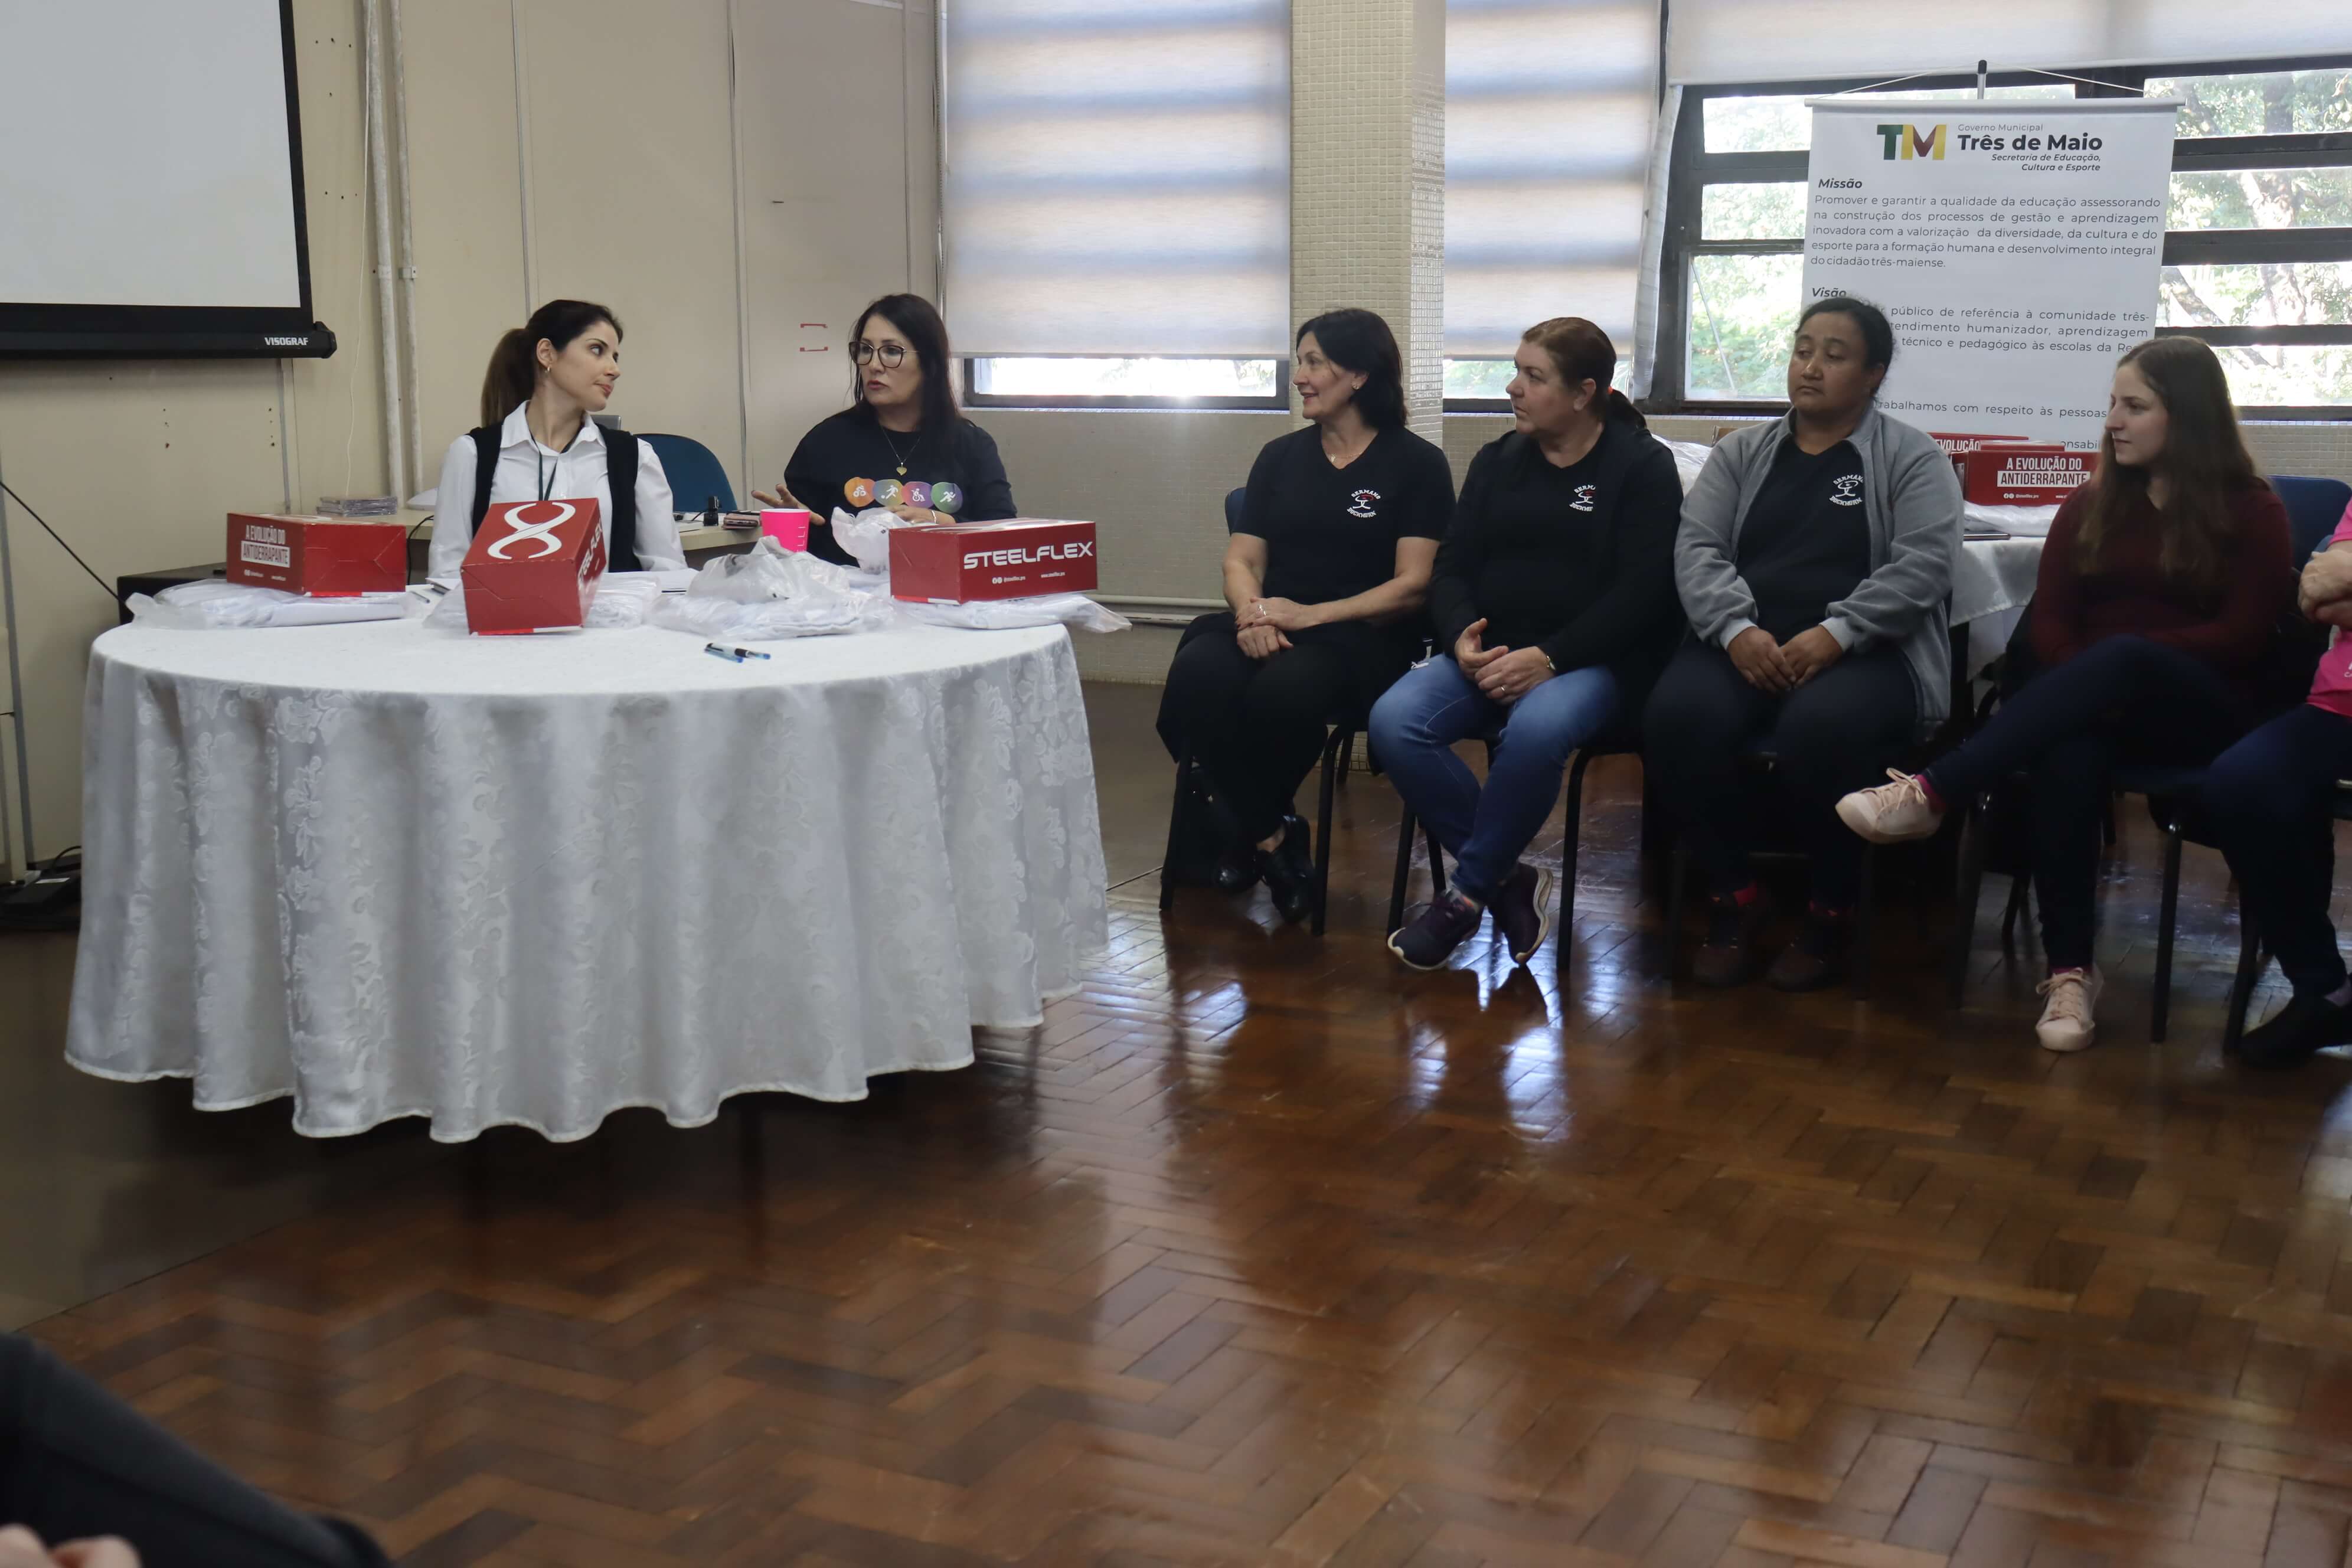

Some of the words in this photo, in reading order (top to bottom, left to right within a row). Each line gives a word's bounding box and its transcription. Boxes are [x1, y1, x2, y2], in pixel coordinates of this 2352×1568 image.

[1998, 123, 2043, 132] Municipal
[1877, 124, 1947, 161] TM
[1956, 134, 2005, 151] Três
[2011, 134, 2041, 151] de
[2047, 132, 2103, 151] Maio
[1991, 153, 2038, 161] Secretaria
[2053, 153, 2101, 162] Educação,
[2021, 163, 2056, 171] Cultura
[2065, 164, 2101, 172] Esporte
[1818, 177, 1863, 189] Missão
[1815, 195, 1868, 205] Promover
[1881, 195, 1926, 207] garantir
[1941, 195, 1997, 208] qualidade
[2001, 196, 2015, 206] da
[2019, 197, 2077, 209] educação
[2080, 197, 2161, 207] assessorando
[1833, 211, 1896, 223] construção
[1901, 211, 1922, 221] dos
[1928, 212, 1984, 223] processos
[1990, 212, 2005, 222] de
[2011, 213, 2052, 224] gestão
[2071, 213, 2158, 225] aprendizagem
[1813, 225, 1866, 236] inovadora
[1906, 226, 1969, 239] valorização
[1977, 227, 1991, 237] da
[1994, 227, 2064, 240] diversidade,
[2067, 228, 2082, 239] da
[2085, 228, 2128, 239] cultura
[2142, 229, 2158, 239] do
[1811, 242, 1853, 251] esporte
[1856, 243, 1879, 253] para
[1891, 241, 1945, 254] formação
[1947, 243, 1995, 253] humana
[2007, 243, 2108, 254] desenvolvimento
[2111, 245, 2156, 257] integral
[1810, 255, 1825, 265] do
[1826, 256, 1870, 266] cidadão
[1871, 257, 1946, 267] três-maiense.
[1891, 306, 1934, 317] público
[1939, 307, 1955, 317] de
[1961, 308, 2020, 319] referência
[2026, 309, 2033, 319] à
[2039, 310, 2116, 321] comunidade
[2123, 312, 2150, 322] três-
[1890, 322, 1960, 332] tendimento
[1966, 323, 2051, 336] humanizador,
[2057, 326, 2148, 337] aprendizagem
[264, 337, 309, 346] VISOGRAF
[1902, 337, 1942, 347] técnico
[1959, 338, 2027, 351] pedagógico
[2031, 340, 2045, 350] às
[2049, 341, 2092, 353] escolas
[2096, 342, 2112, 352] da
[1953, 404, 1979, 413] com
[1985, 405, 2034, 416] respeito
[2040, 406, 2053, 416] às
[2059, 409, 2107, 419] pessoas
[2007, 458, 2014, 471] A
[2015, 456, 2066, 472] EVOLUÇÃO
[2068, 458, 2082, 471] DO
[246, 524, 250, 540] A
[250, 525, 277, 543] EVOLUÇÃO
[277, 529, 285, 544] DO
[243, 543, 288, 564] ANTIDERRAPANTE
[963, 541, 1093, 570] STEELFLEX
